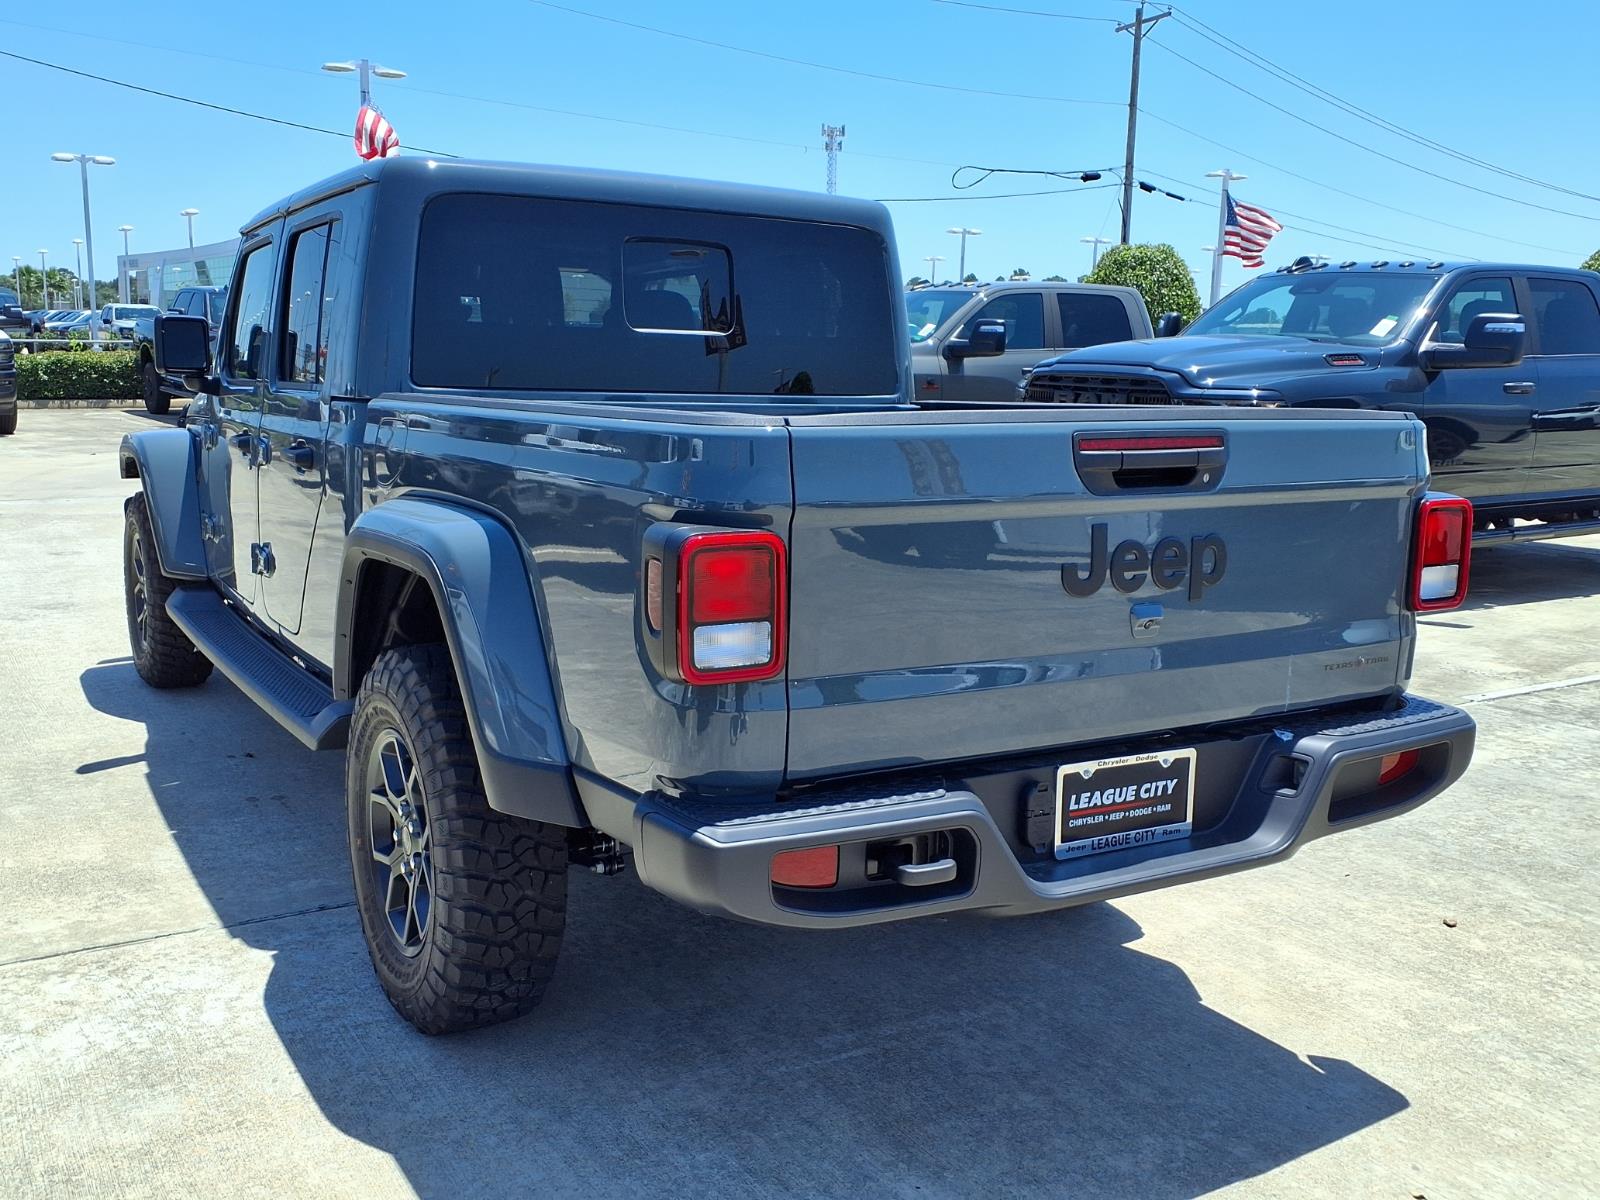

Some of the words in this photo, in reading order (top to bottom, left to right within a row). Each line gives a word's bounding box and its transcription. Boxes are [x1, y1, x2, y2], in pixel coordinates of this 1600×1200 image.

[1061, 523, 1227, 602] Jeep
[1097, 758, 1129, 768] Chrysler
[1135, 753, 1159, 763] Dodge
[1069, 785, 1137, 811] LEAGUE
[1140, 778, 1179, 799] CITY
[1069, 815, 1104, 828] CHRYSLER
[1109, 811, 1125, 821] JEEP
[1129, 807, 1152, 818] DODGE
[1157, 804, 1171, 813] RAM
[1065, 844, 1087, 854] Jeep
[1091, 835, 1131, 851] LEAGUE
[1134, 829, 1157, 843] CITY
[1162, 828, 1181, 837] Ram
